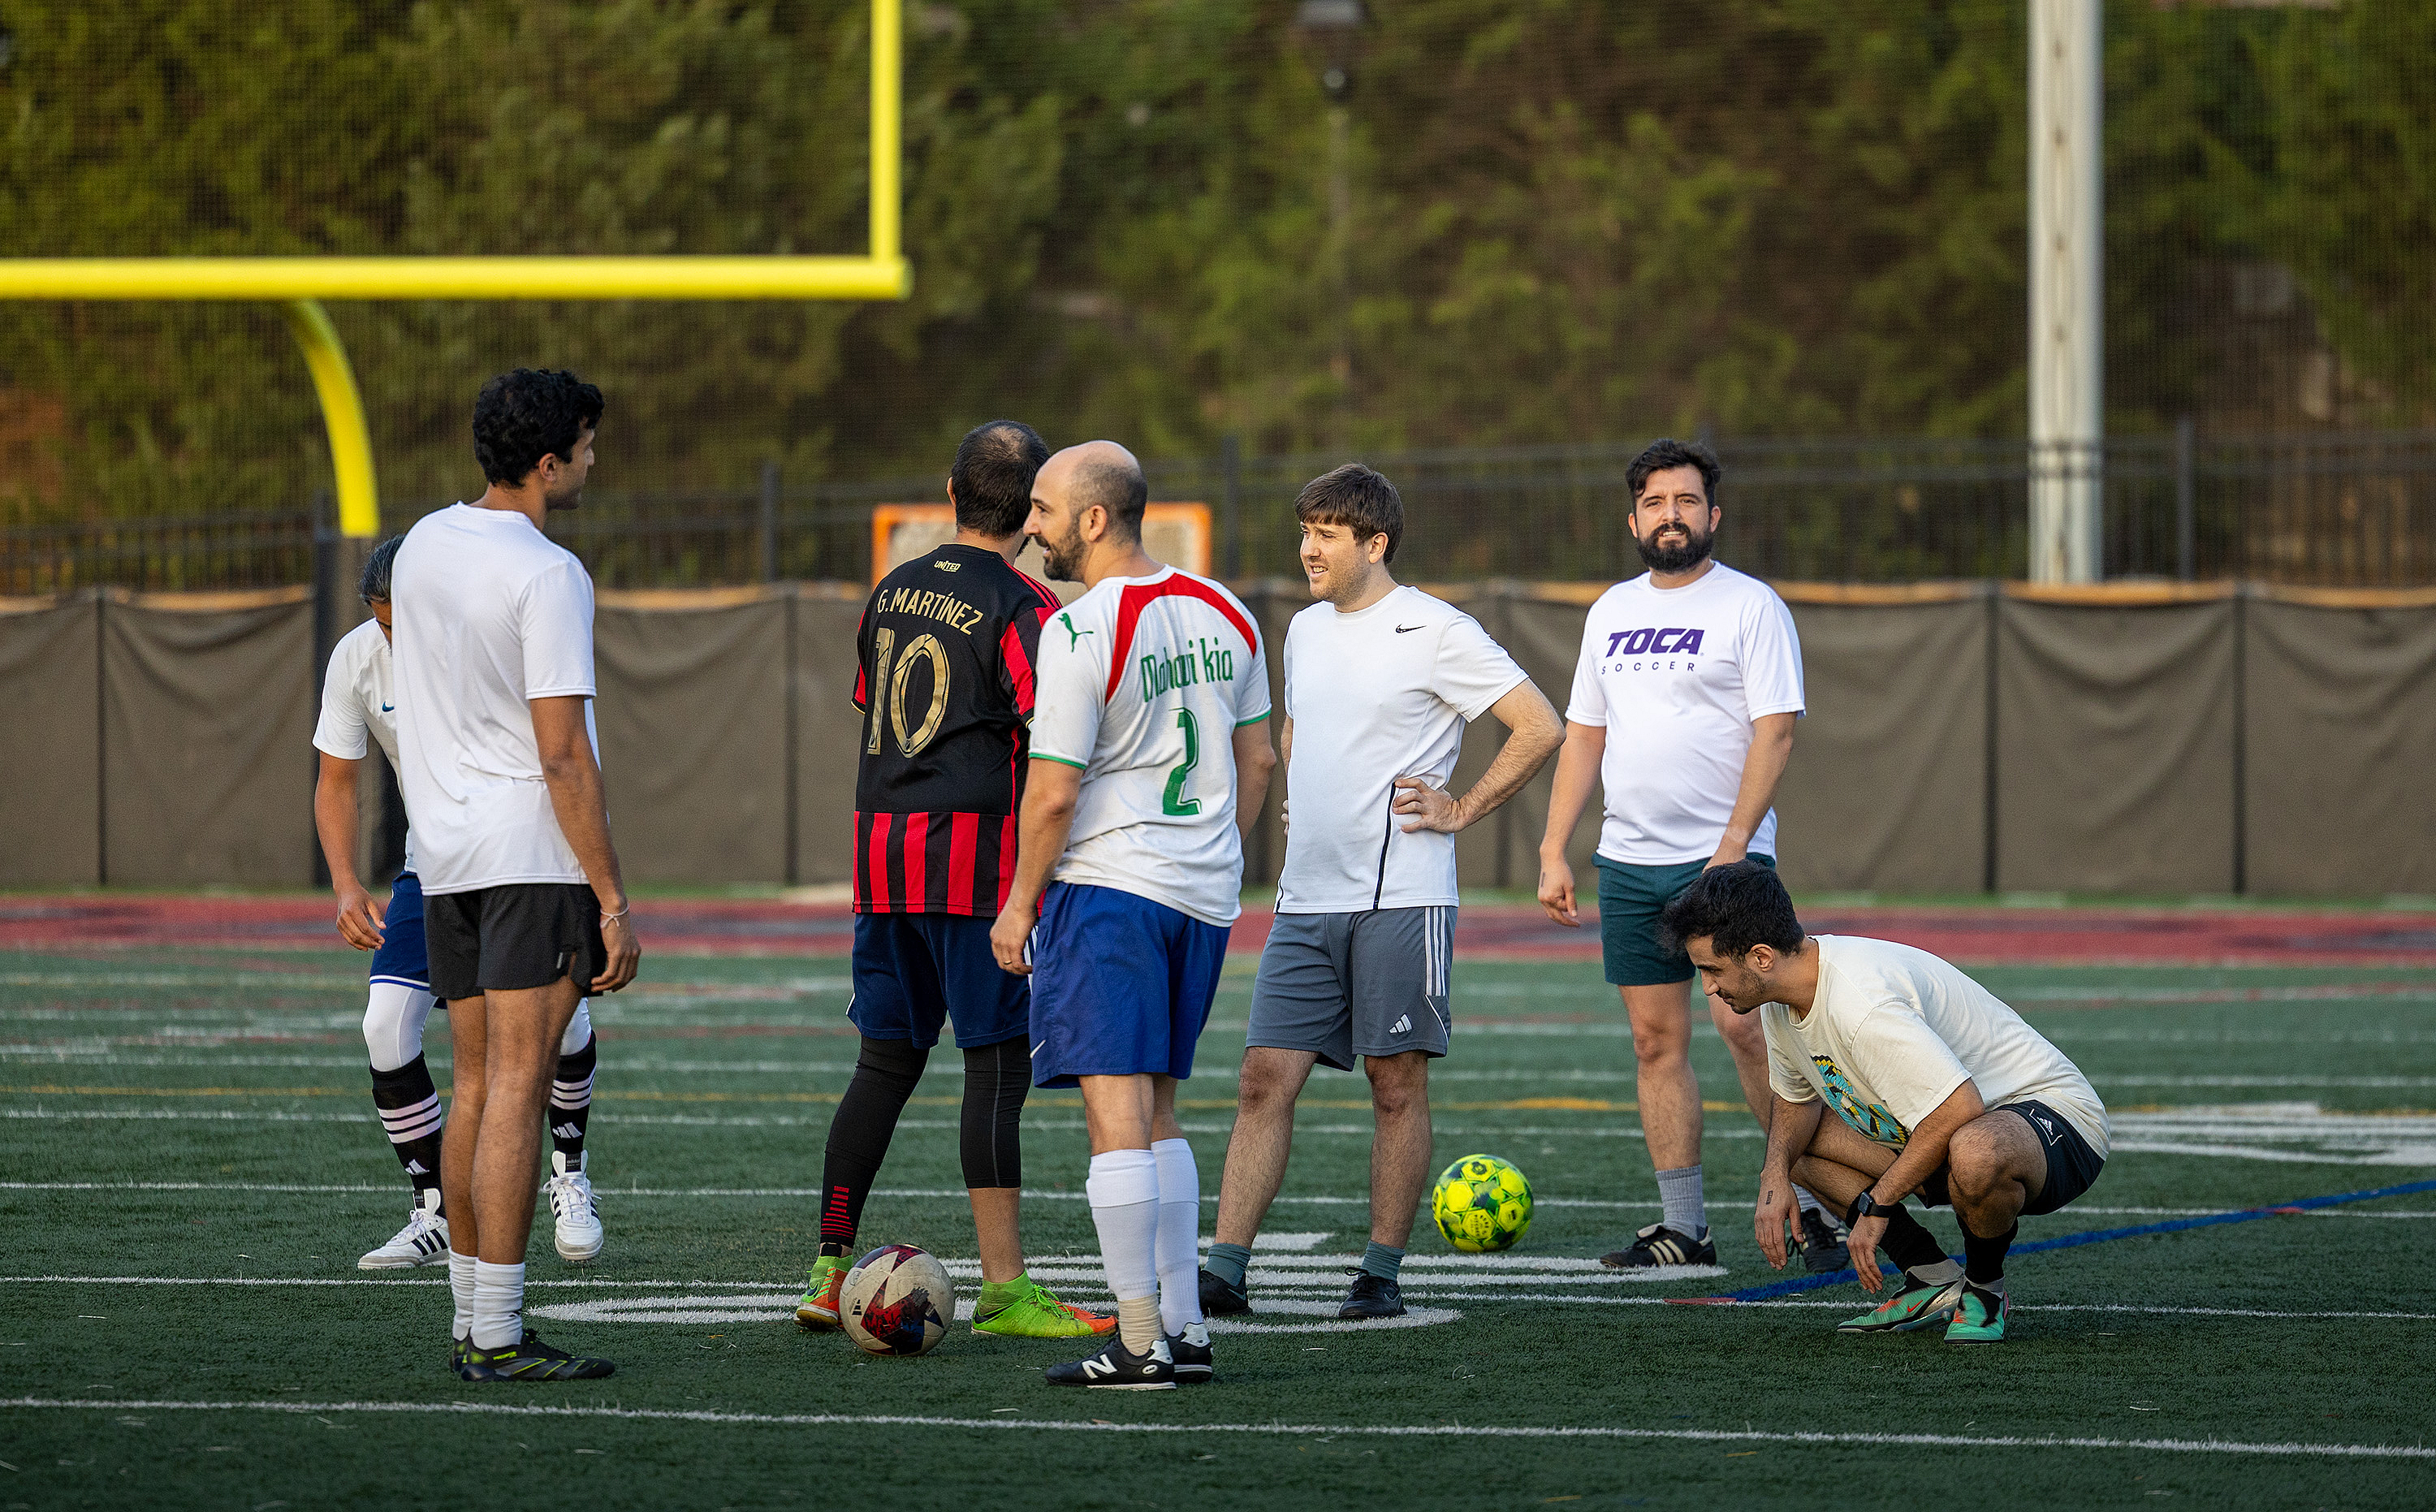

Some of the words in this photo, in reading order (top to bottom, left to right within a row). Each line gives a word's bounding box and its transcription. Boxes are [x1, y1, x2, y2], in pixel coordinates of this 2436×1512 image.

[934, 560, 961, 570] UNITED
[877, 587, 984, 635] G.MARTÍNEZ
[1605, 628, 1705, 658] TOCA
[1601, 661, 1695, 675] SOCCER
[867, 627, 951, 758] 10
[1162, 706, 1203, 816] 2
[1082, 1354, 1118, 1380] N
